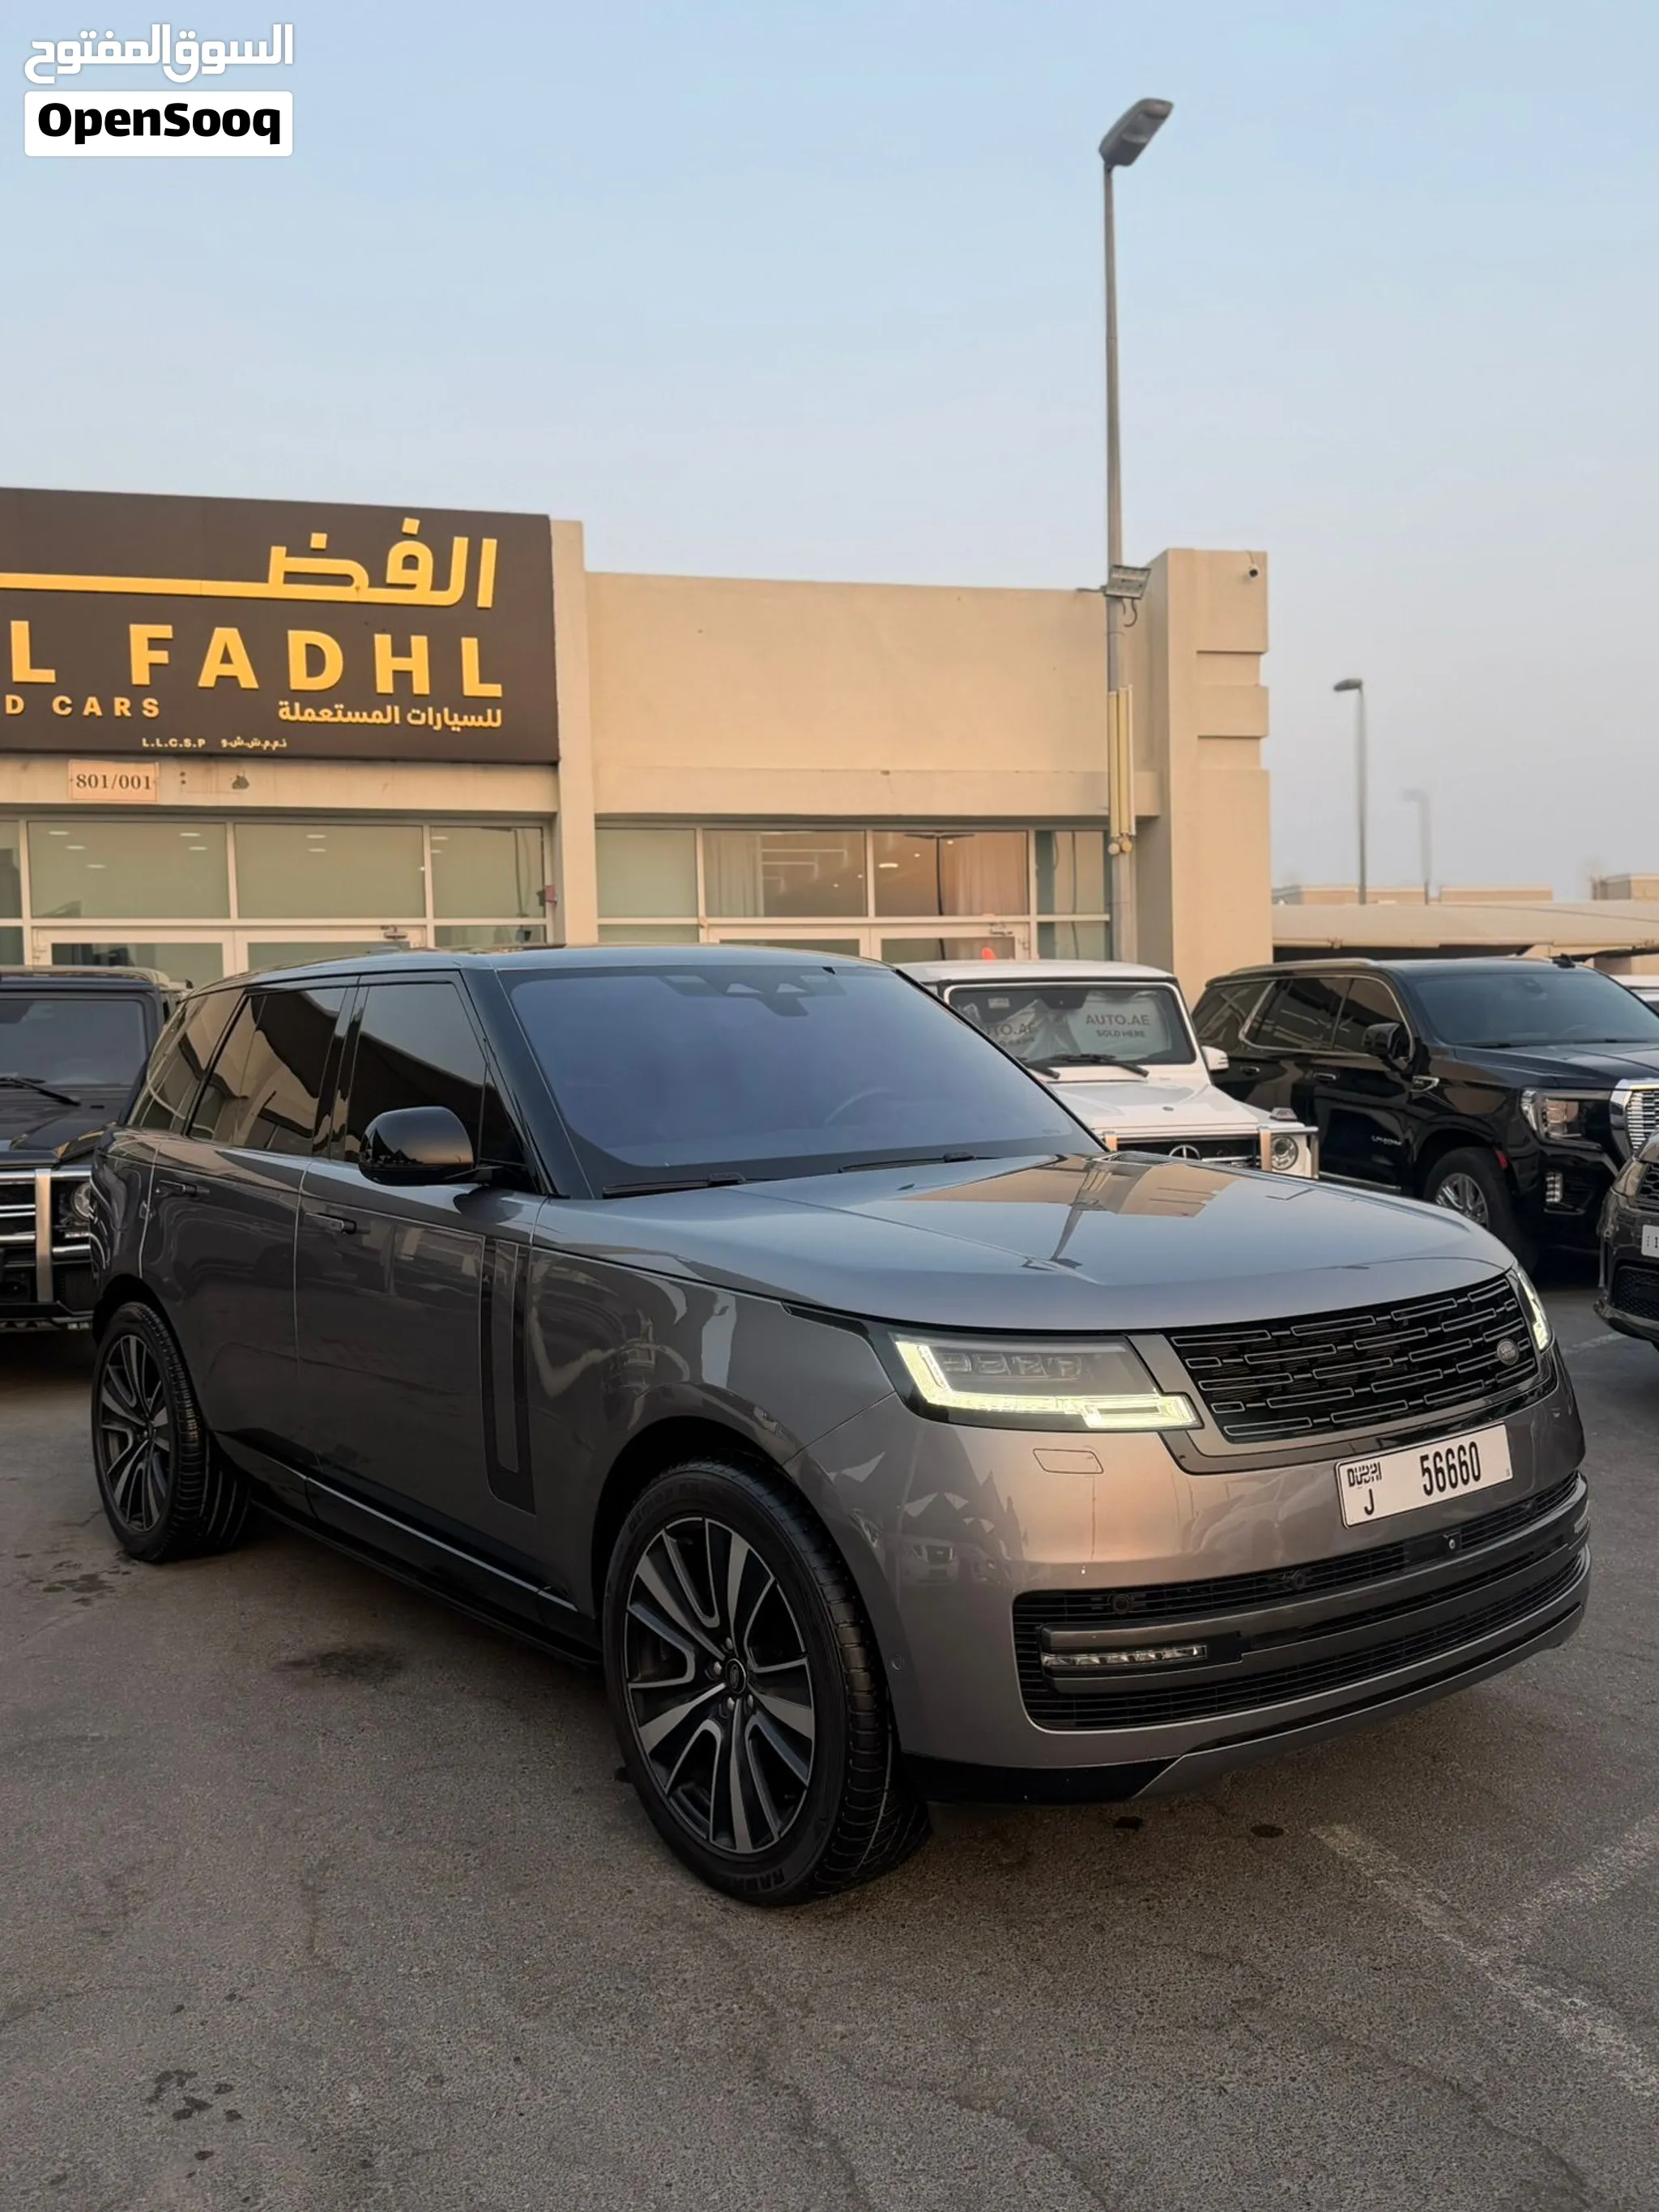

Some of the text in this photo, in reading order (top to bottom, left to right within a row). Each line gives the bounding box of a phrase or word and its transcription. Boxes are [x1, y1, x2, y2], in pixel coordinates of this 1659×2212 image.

[130, 624, 503, 697] FADHL
[52, 695, 160, 718] CARS
[278, 701, 502, 732] للسيارات المستعملة
[142, 738, 206, 748] L.L.C.S.P
[75, 774, 152, 791] 801/001
[1086, 1014, 1150, 1026] AUTO.AE
[1419, 1441, 1482, 1496] 56660
[1363, 1488, 1375, 1515] J
